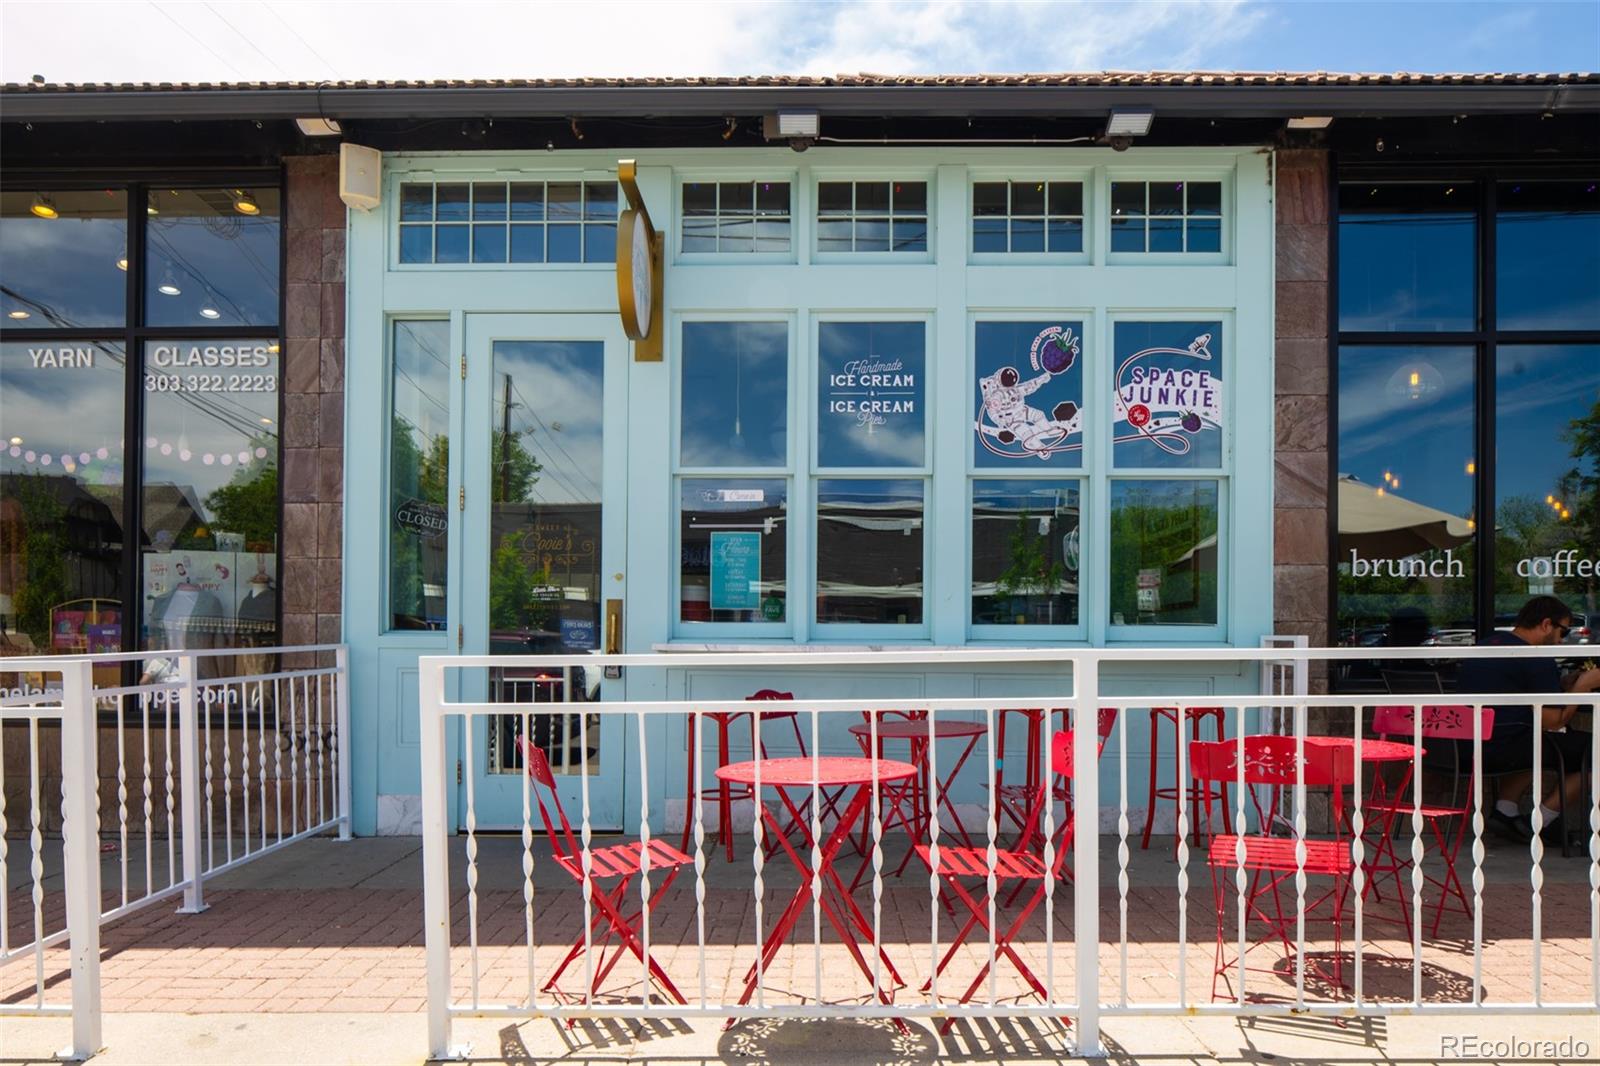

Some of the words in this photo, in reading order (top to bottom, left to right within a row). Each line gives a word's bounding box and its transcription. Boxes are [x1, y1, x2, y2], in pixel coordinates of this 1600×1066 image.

[28, 348, 95, 368] YARN
[154, 346, 270, 368] CLASSES
[843, 358, 904, 377] Handmade
[144, 375, 278, 393] 303.322.2223
[830, 374, 856, 387] ICE
[859, 374, 915, 387] CREAM
[1132, 367, 1211, 389] SPACE
[830, 400, 856, 413] ICE
[859, 400, 915, 413] CREAM
[1123, 387, 1215, 408] JUNKIE
[397, 510, 448, 530] CLOSED
[1349, 548, 1466, 578] brunch
